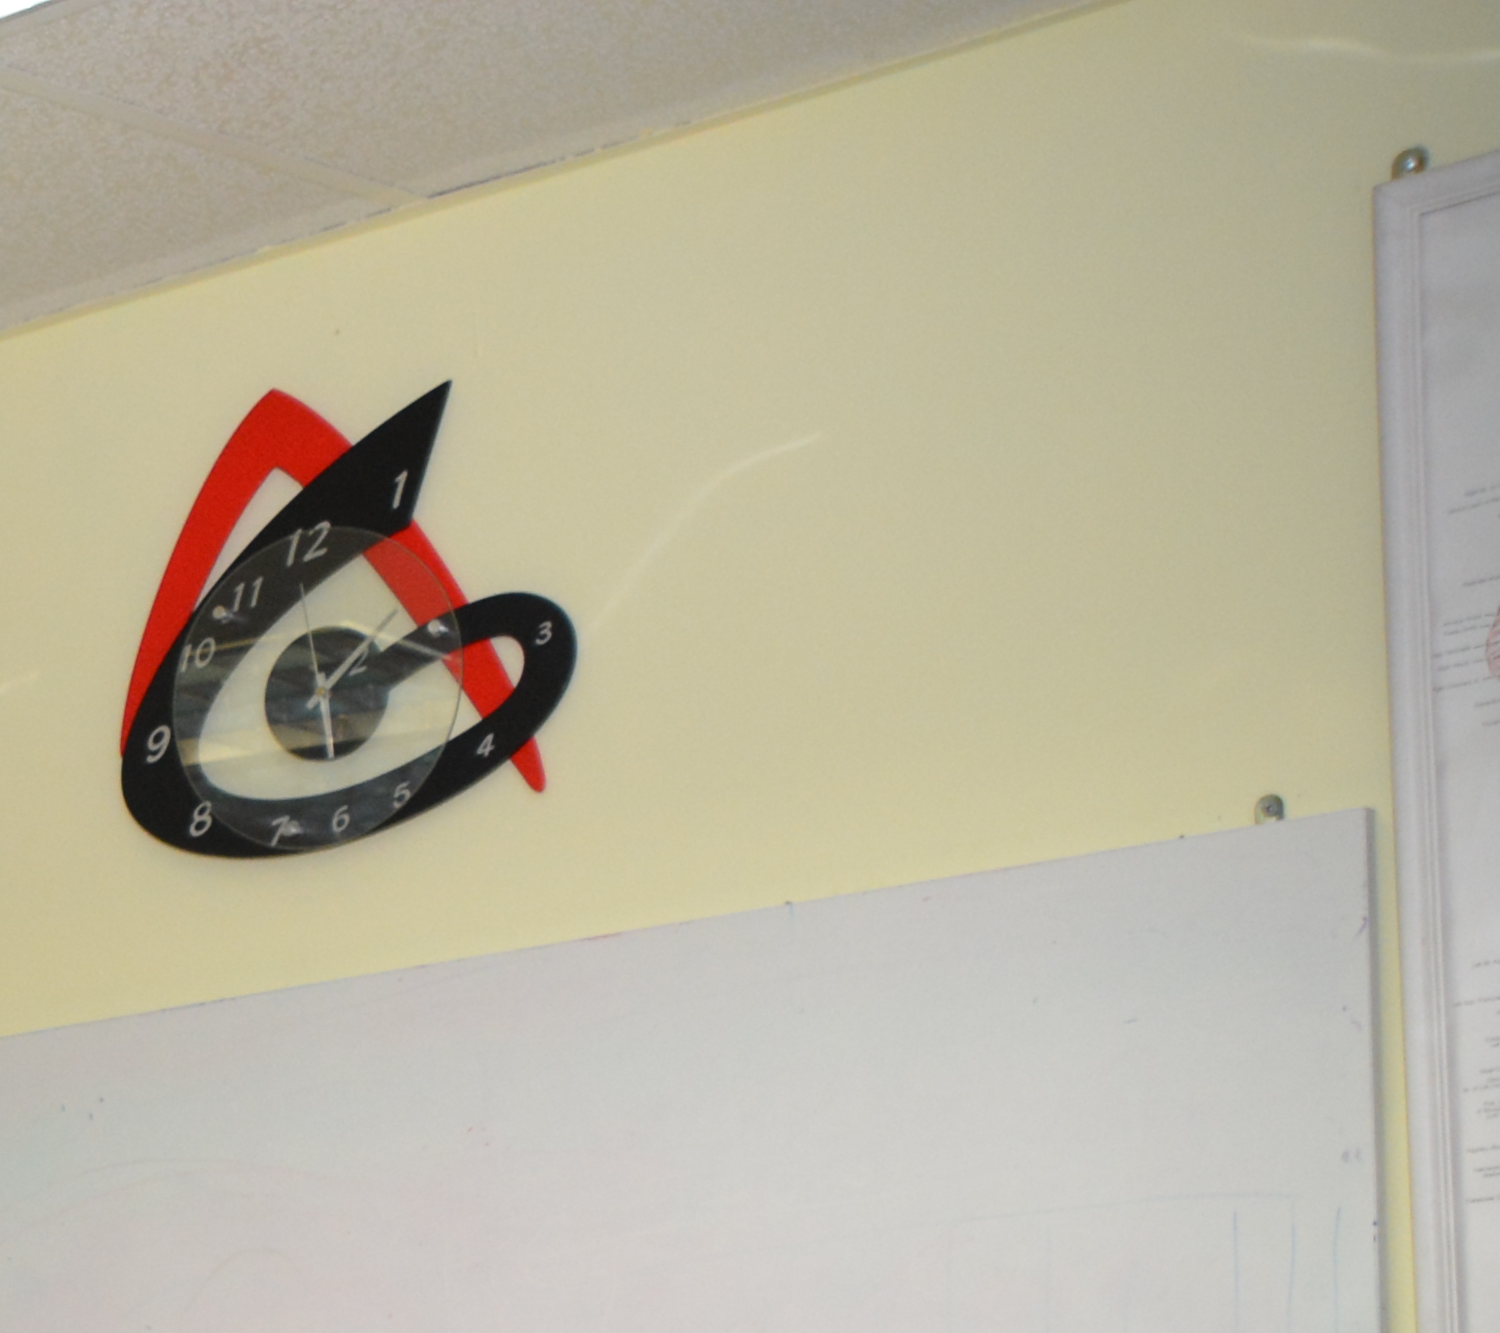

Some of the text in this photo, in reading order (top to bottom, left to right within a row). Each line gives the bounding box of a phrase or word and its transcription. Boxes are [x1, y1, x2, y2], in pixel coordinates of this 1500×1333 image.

[391, 469, 409, 510] 1
[285, 520, 332, 567] 12
[231, 576, 264, 612] 11
[534, 620, 553, 646] 3
[180, 636, 217, 673] 10
[348, 646, 369, 677] 2
[145, 724, 172, 764] 9
[475, 732, 496, 758] 4
[392, 782, 412, 809] 5
[188, 801, 213, 837] 8
[271, 815, 291, 847] 7
[332, 805, 351, 833] 6
